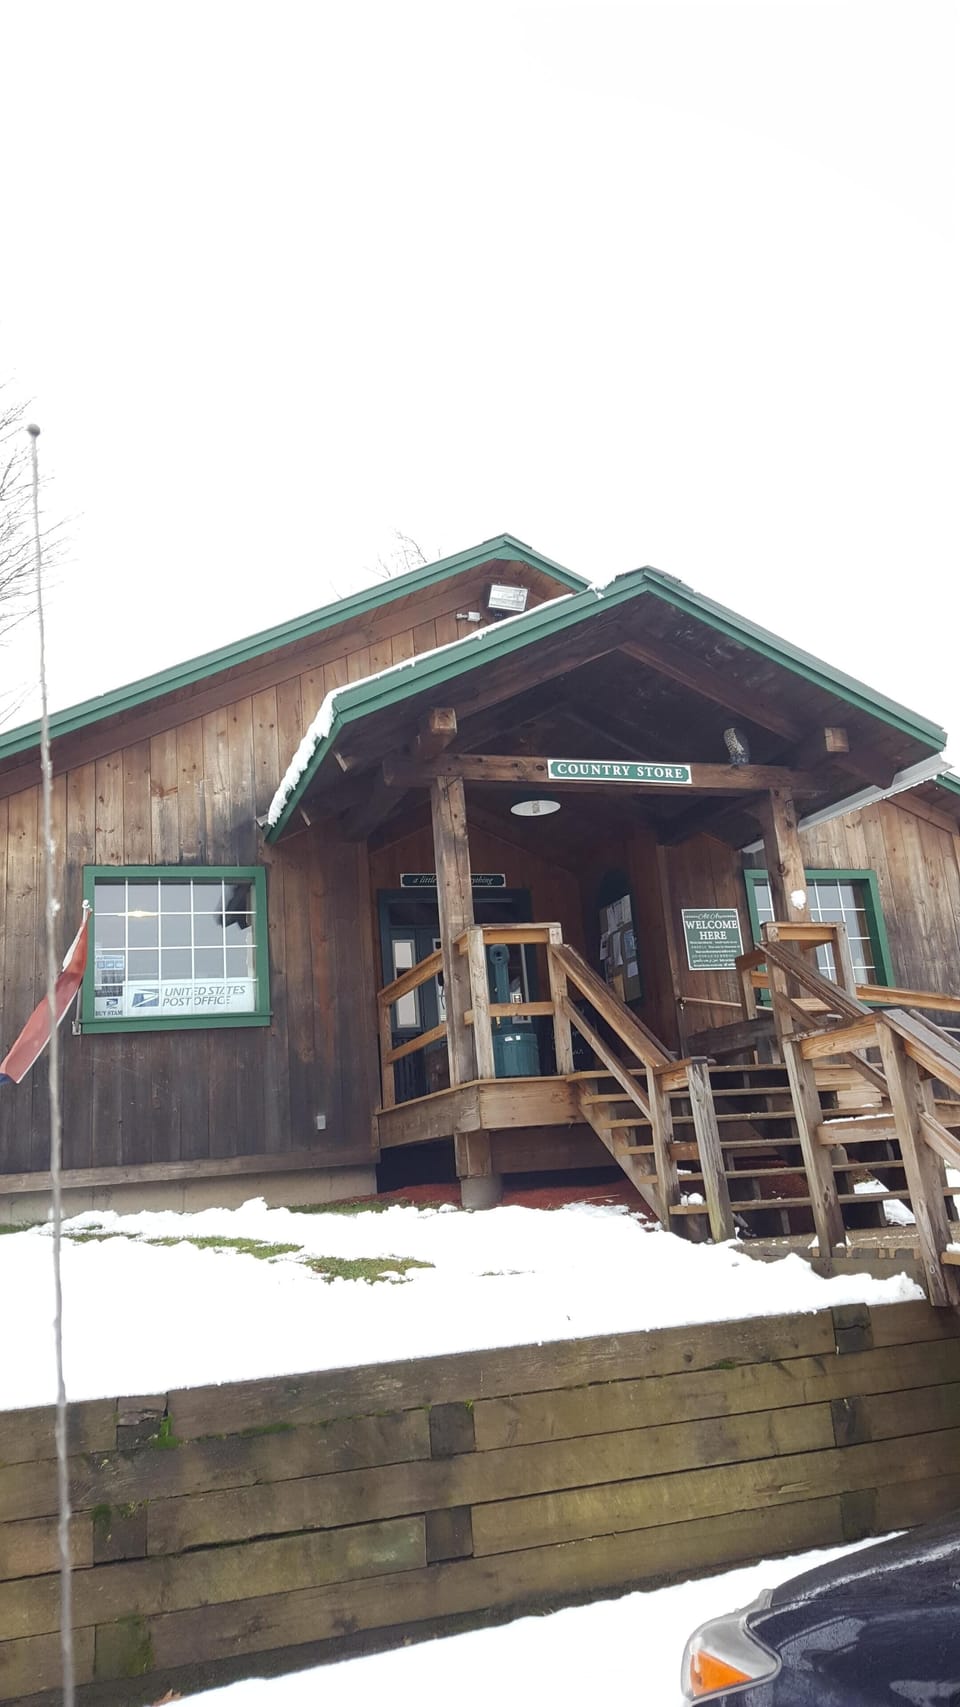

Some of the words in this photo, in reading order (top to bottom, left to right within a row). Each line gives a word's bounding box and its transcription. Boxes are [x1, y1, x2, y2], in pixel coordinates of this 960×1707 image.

[557, 763, 630, 776] COUNTRY
[637, 767, 684, 779] STORE
[685, 920, 738, 930] WELCOME
[699, 931, 727, 940] HERE
[165, 987, 207, 997] UNITED
[162, 997, 193, 1007] POST
[194, 996, 231, 1006] OFFICE
